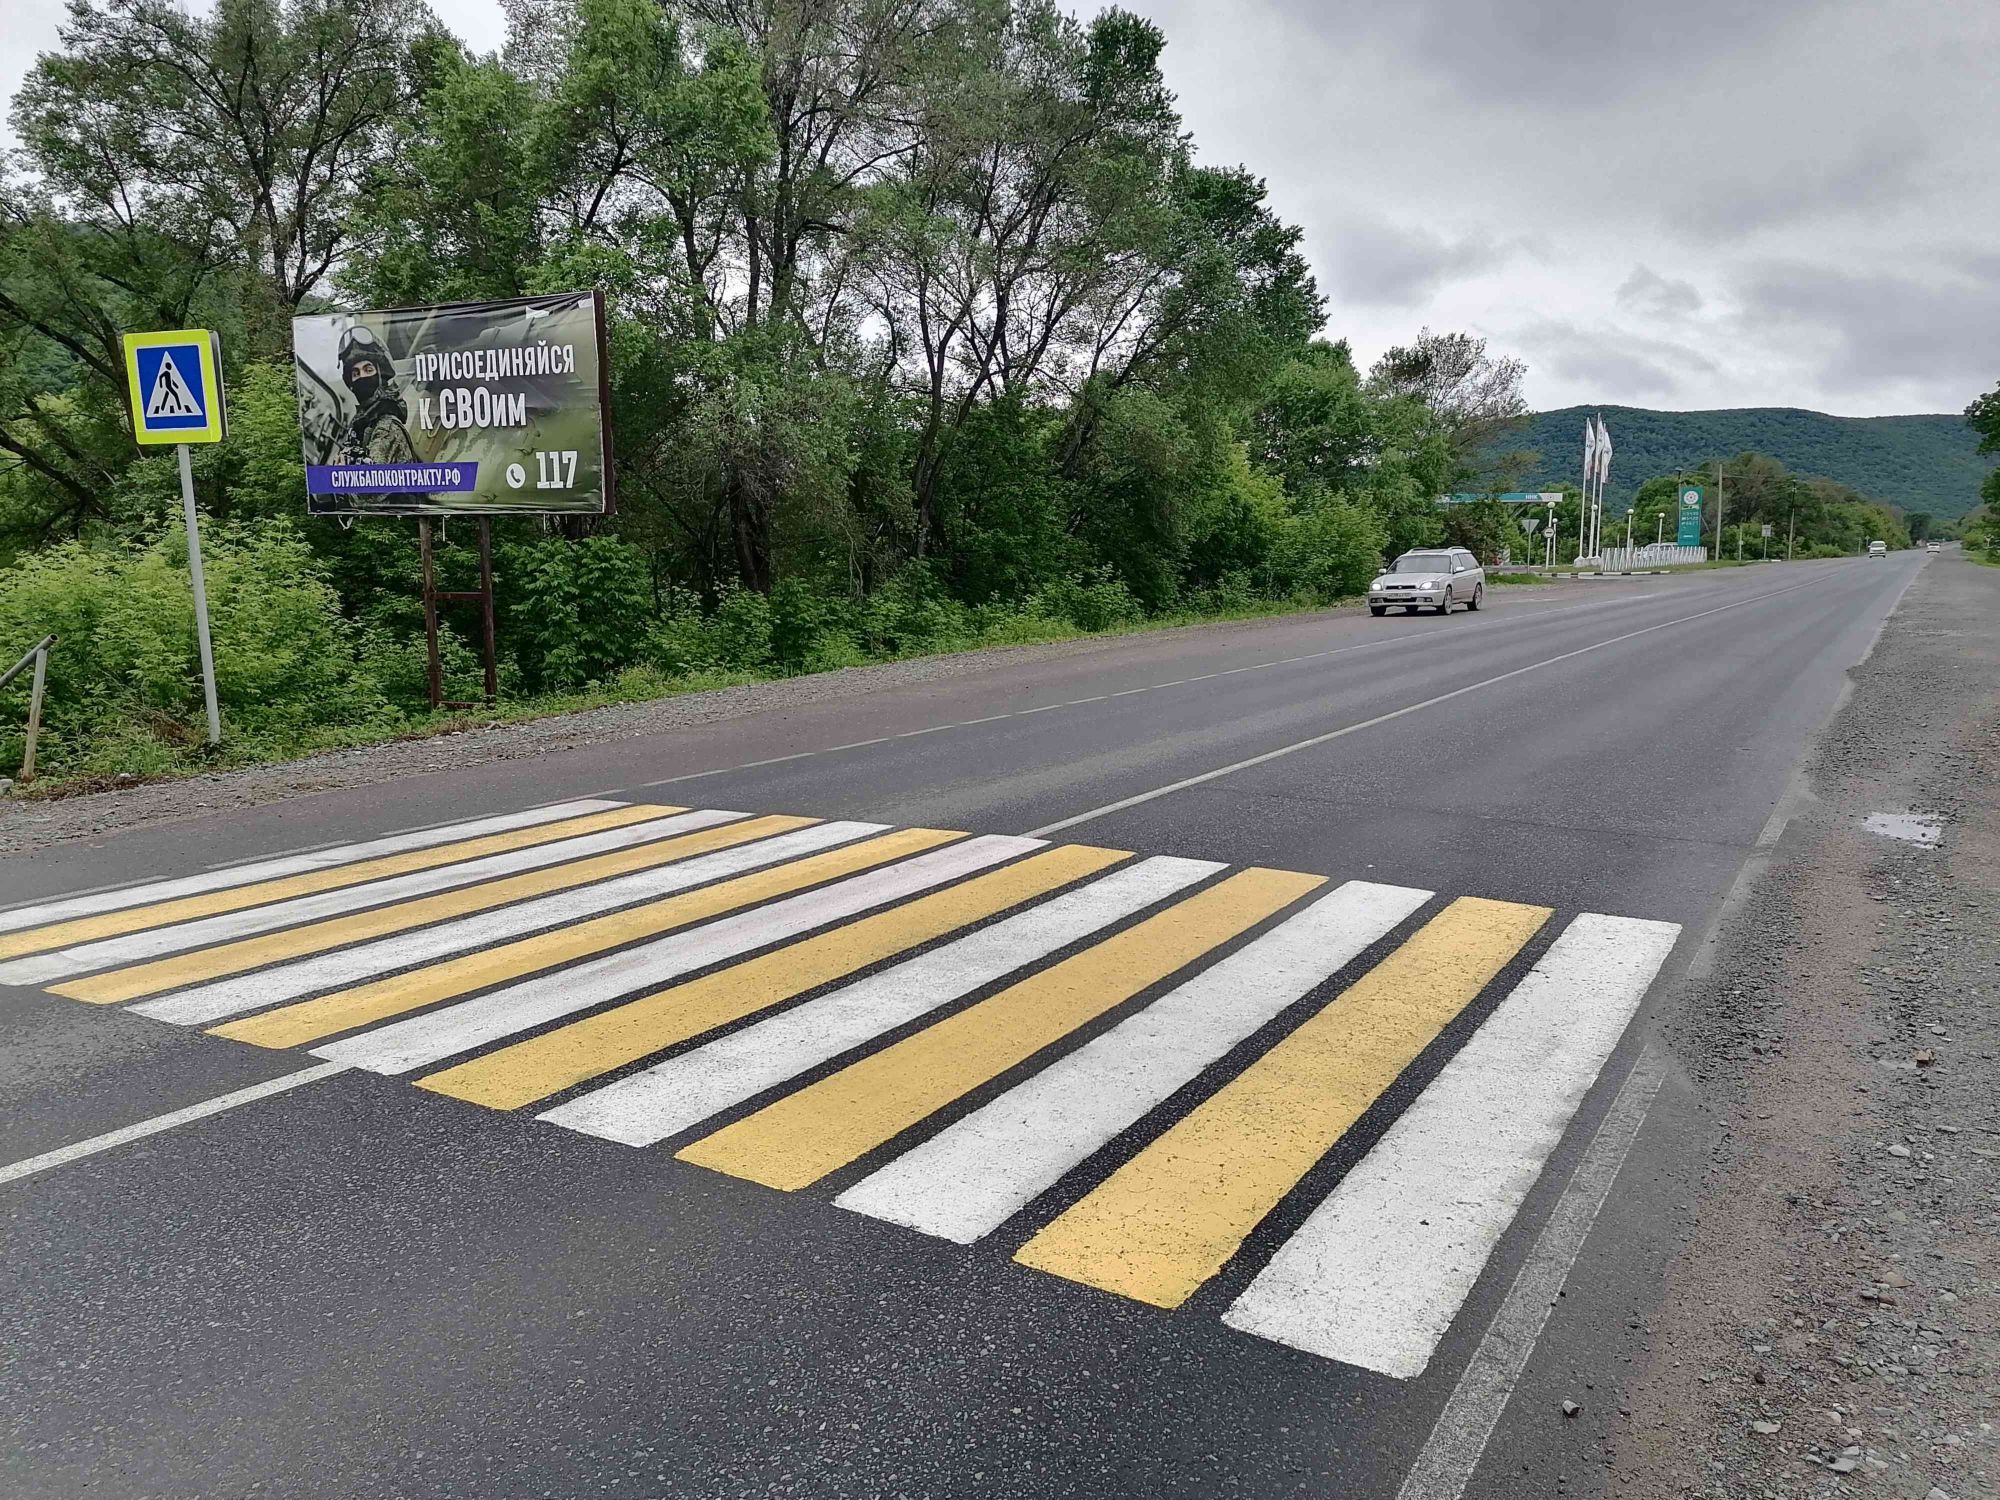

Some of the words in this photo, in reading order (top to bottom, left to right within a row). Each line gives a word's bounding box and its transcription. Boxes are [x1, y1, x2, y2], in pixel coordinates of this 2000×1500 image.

[415, 340, 575, 382] ПРИСОЕДИНЯЙСЯ
[331, 468, 461, 488] СЛУЖБАПОКОНТРАКТУ.РФ
[535, 450, 578, 489] 117
